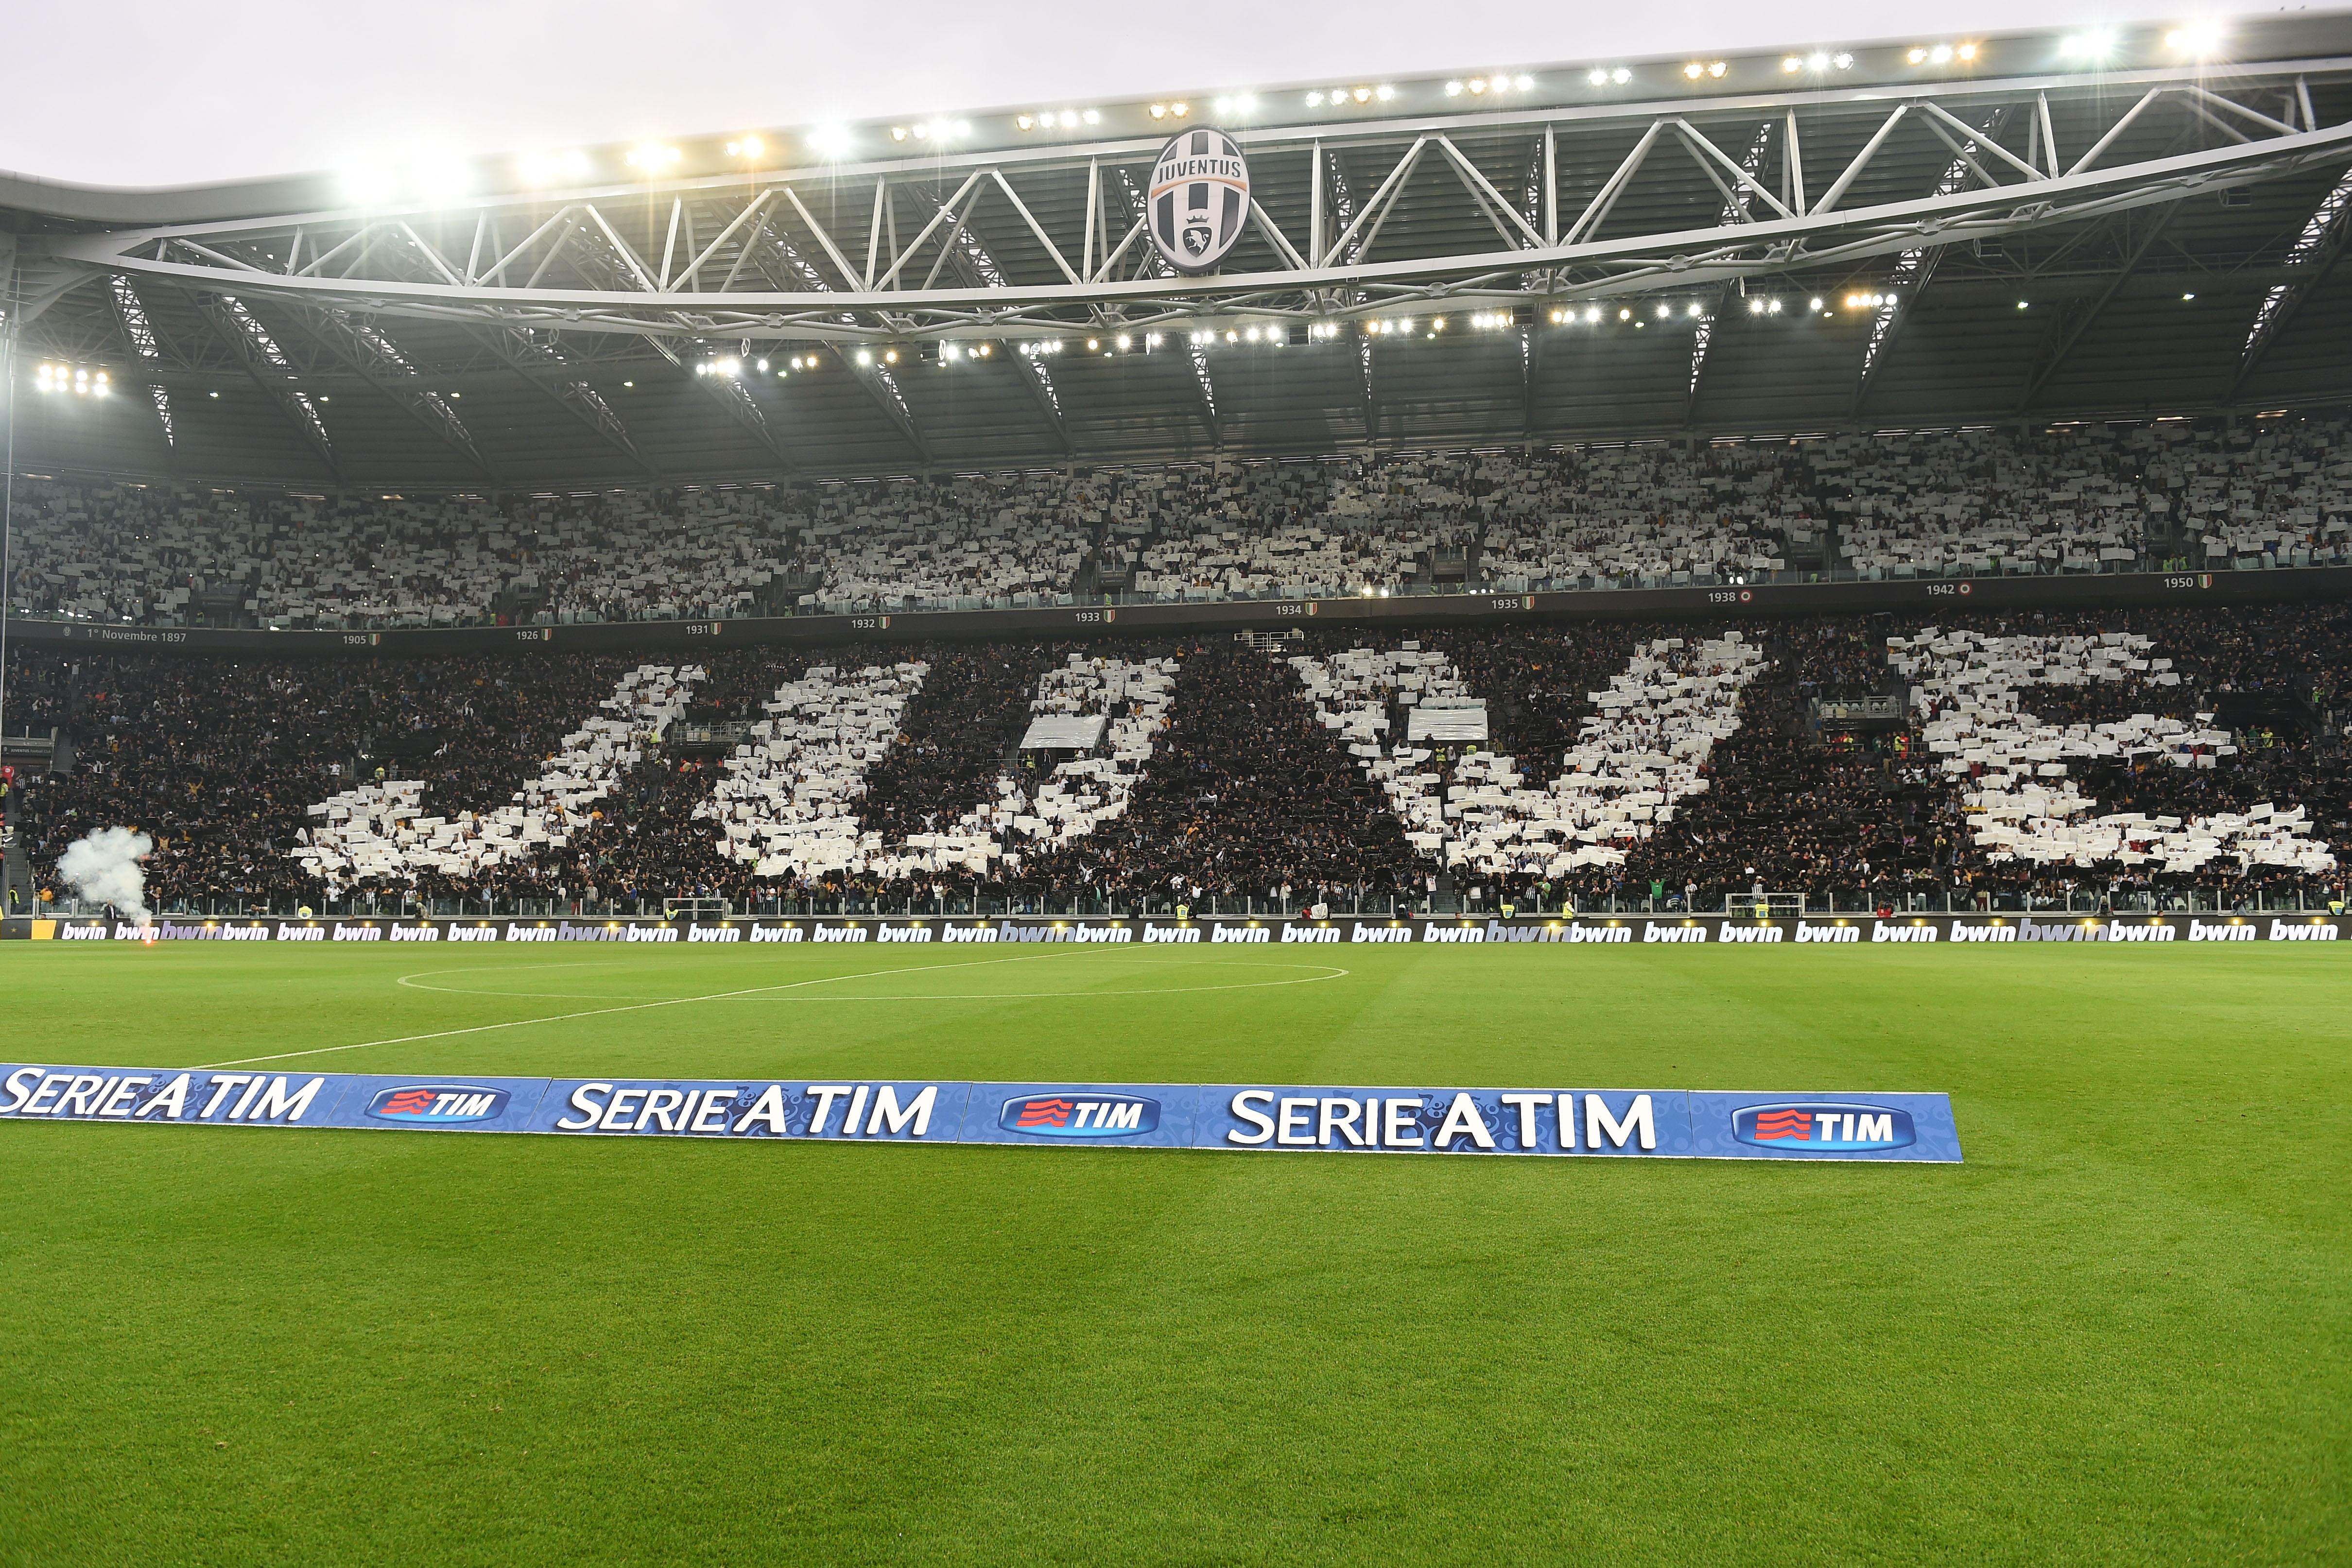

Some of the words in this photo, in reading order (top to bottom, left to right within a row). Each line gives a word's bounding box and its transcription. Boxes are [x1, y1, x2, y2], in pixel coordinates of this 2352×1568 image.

[1158, 159, 1241, 184] JUVENTUS
[2164, 577, 2193, 588] 1950
[1926, 584, 1955, 596] 1942
[1708, 592, 1736, 603] 1938
[1491, 599, 1518, 609] 1935
[1276, 605, 1302, 616] 1934
[1075, 612, 1100, 622] 1933
[686, 625, 709, 635] 1931
[851, 619, 875, 629] 1932
[87, 628, 99, 638] 1°
[102, 629, 157, 642] Novembre
[161, 632, 186, 643] 1897
[343, 635, 366, 644] 1905
[516, 631, 538, 640] 1926
[62, 922, 106, 940] bwin
[114, 922, 161, 940] bwin
[161, 921, 223, 940] bwin
[222, 922, 269, 940] bwin
[277, 923, 324, 941] bwin
[333, 922, 381, 941] bwin
[389, 922, 438, 941] bwin
[448, 922, 496, 941] bwin
[506, 922, 556, 941] bwin
[557, 921, 627, 941] bwin
[626, 923, 678, 942] bwin
[688, 923, 740, 942] bwin
[750, 923, 803, 942] bwin
[813, 923, 867, 942] bwin
[877, 923, 932, 942] bwin
[942, 923, 997, 942] bwin
[998, 921, 1076, 942] bwin
[1074, 923, 1132, 942] bwin
[1142, 923, 1201, 943] bwin
[1211, 923, 1270, 942] bwin
[1280, 923, 1341, 942] bwin
[1351, 923, 1412, 942] bwin
[1422, 923, 1484, 942] bwin
[1486, 920, 1572, 942] bwin
[1570, 922, 1632, 942] bwin
[1643, 921, 1707, 942] bwin
[1718, 921, 1783, 942] bwin
[1795, 921, 1860, 942] bwin
[1872, 921, 1937, 942] bwin
[1950, 920, 2016, 942] bwin
[2017, 918, 2109, 941] bwin
[2108, 920, 2176, 941] bwin
[2188, 919, 2256, 941] bwin
[2269, 919, 2338, 941] bwin
[0, 1068, 147, 1116] SERIE
[137, 1073, 185, 1118] A
[198, 1074, 325, 1120] TIM
[429, 1093, 498, 1117] TIM
[558, 1083, 739, 1133] SERIE
[732, 1085, 787, 1133] A
[807, 1085, 939, 1135] TIM
[1074, 1103, 1143, 1129] TIM
[1228, 1089, 1424, 1147] SERIE
[1434, 1092, 1496, 1147] A
[1502, 1093, 1656, 1150] TIM
[1815, 1113, 1893, 1142] TIM
